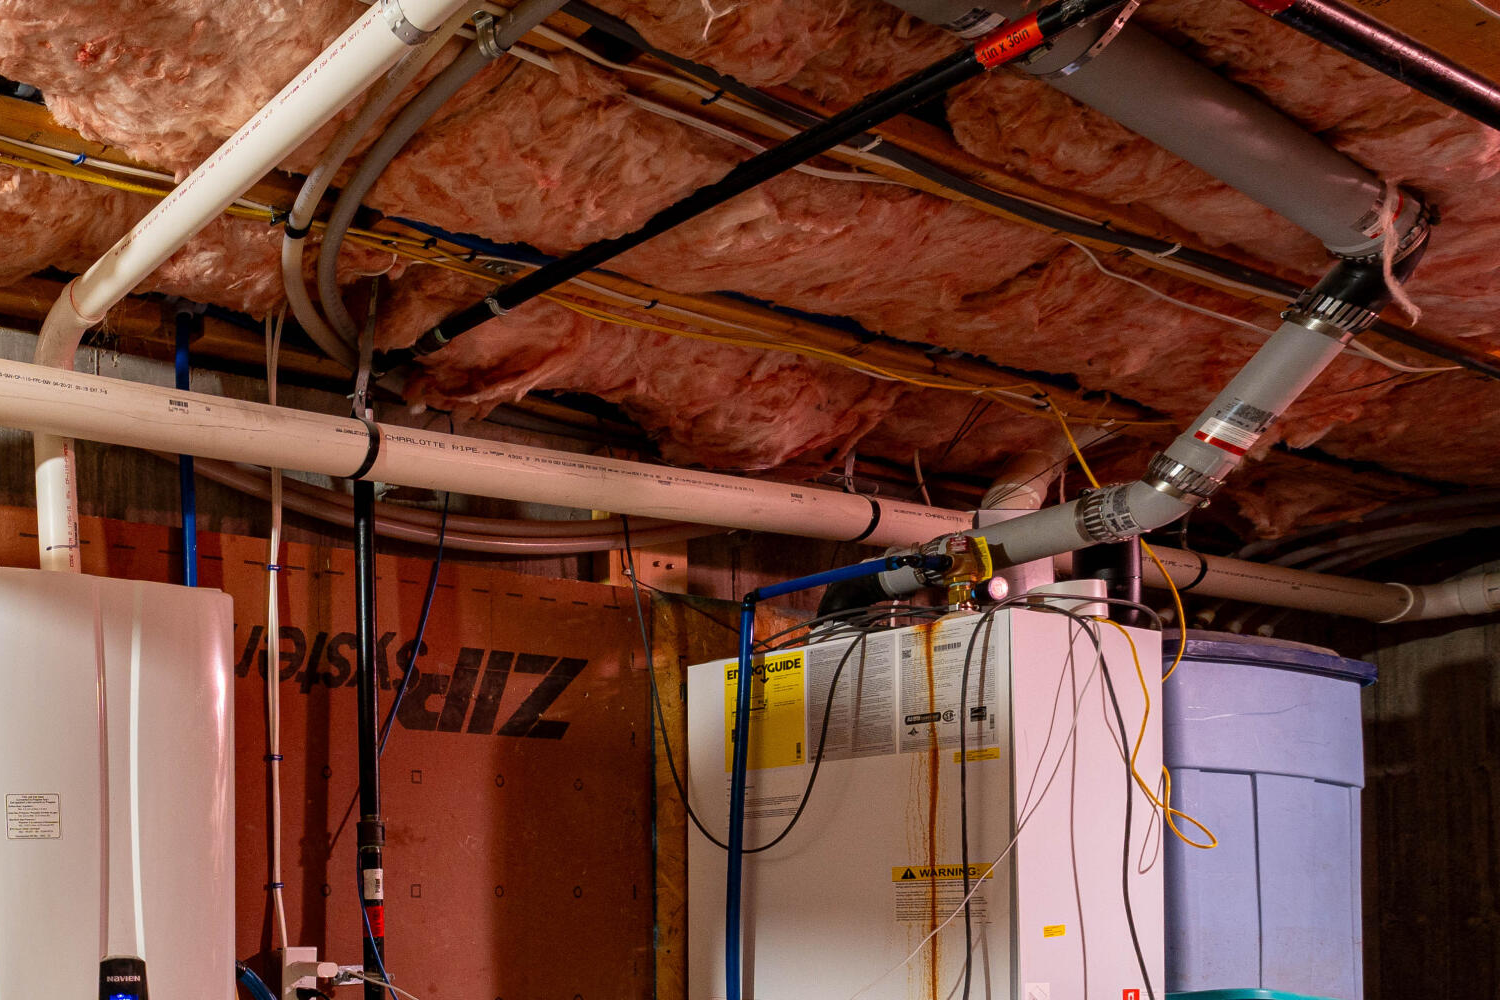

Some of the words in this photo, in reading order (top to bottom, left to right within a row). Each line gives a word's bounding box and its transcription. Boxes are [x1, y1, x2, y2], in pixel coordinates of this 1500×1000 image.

[999, 42, 1007, 53] x
[1007, 29, 1030, 48] 36in
[384, 434, 446, 449] CHARLOTTE
[726, 658, 802, 681] ENGYGUIDE
